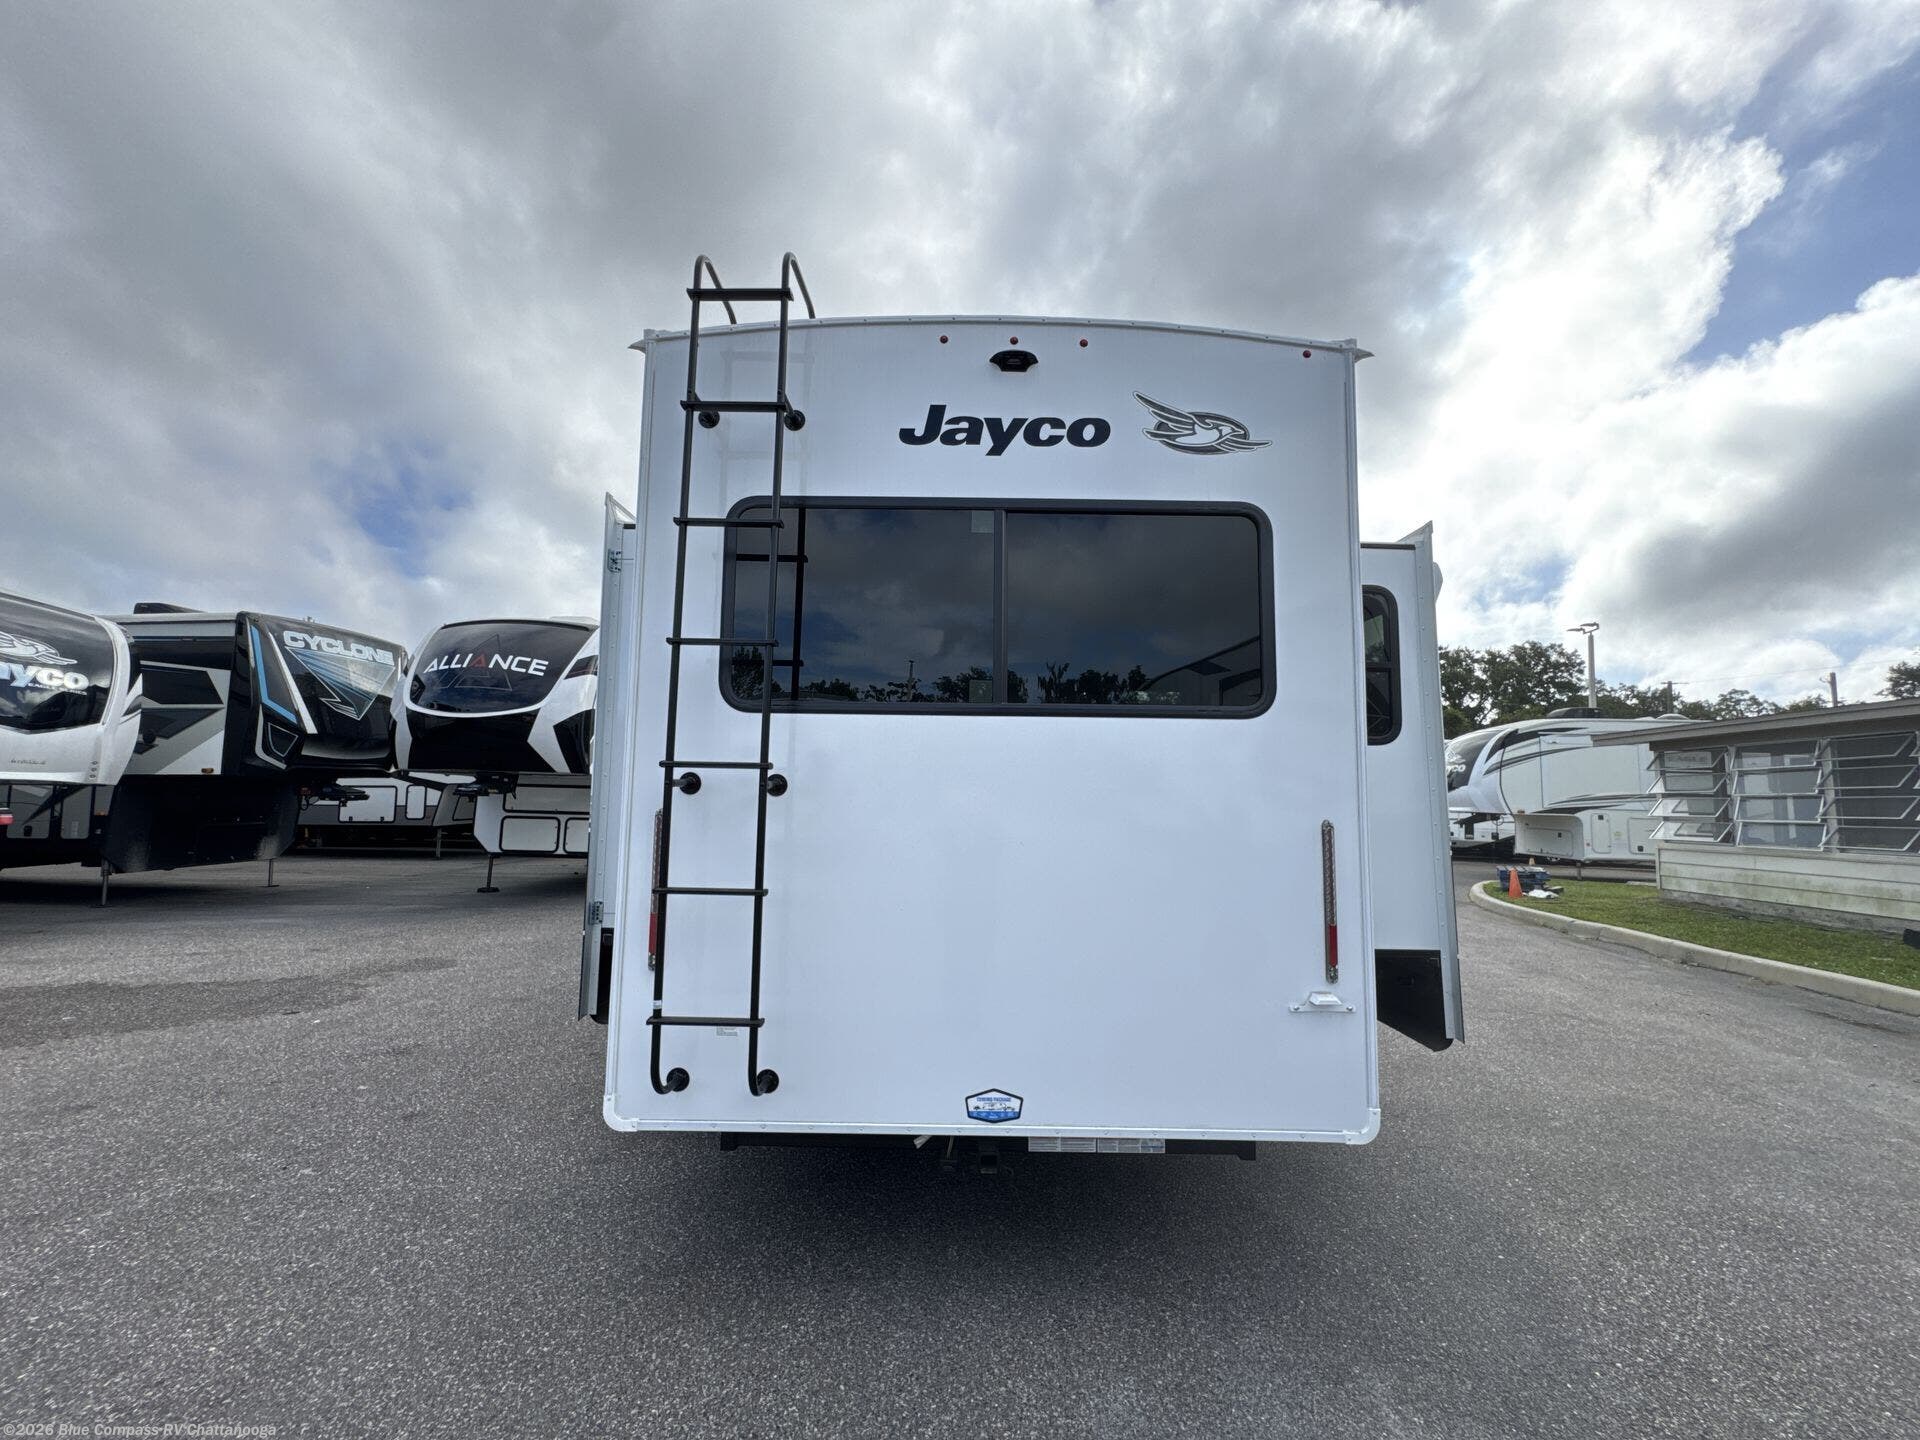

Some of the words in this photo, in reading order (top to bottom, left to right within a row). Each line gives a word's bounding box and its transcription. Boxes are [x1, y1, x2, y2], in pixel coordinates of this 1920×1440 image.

[898, 404, 1111, 456] Jayco
[283, 630, 394, 666] CYCLONE
[423, 652, 549, 676] ALLIANCE
